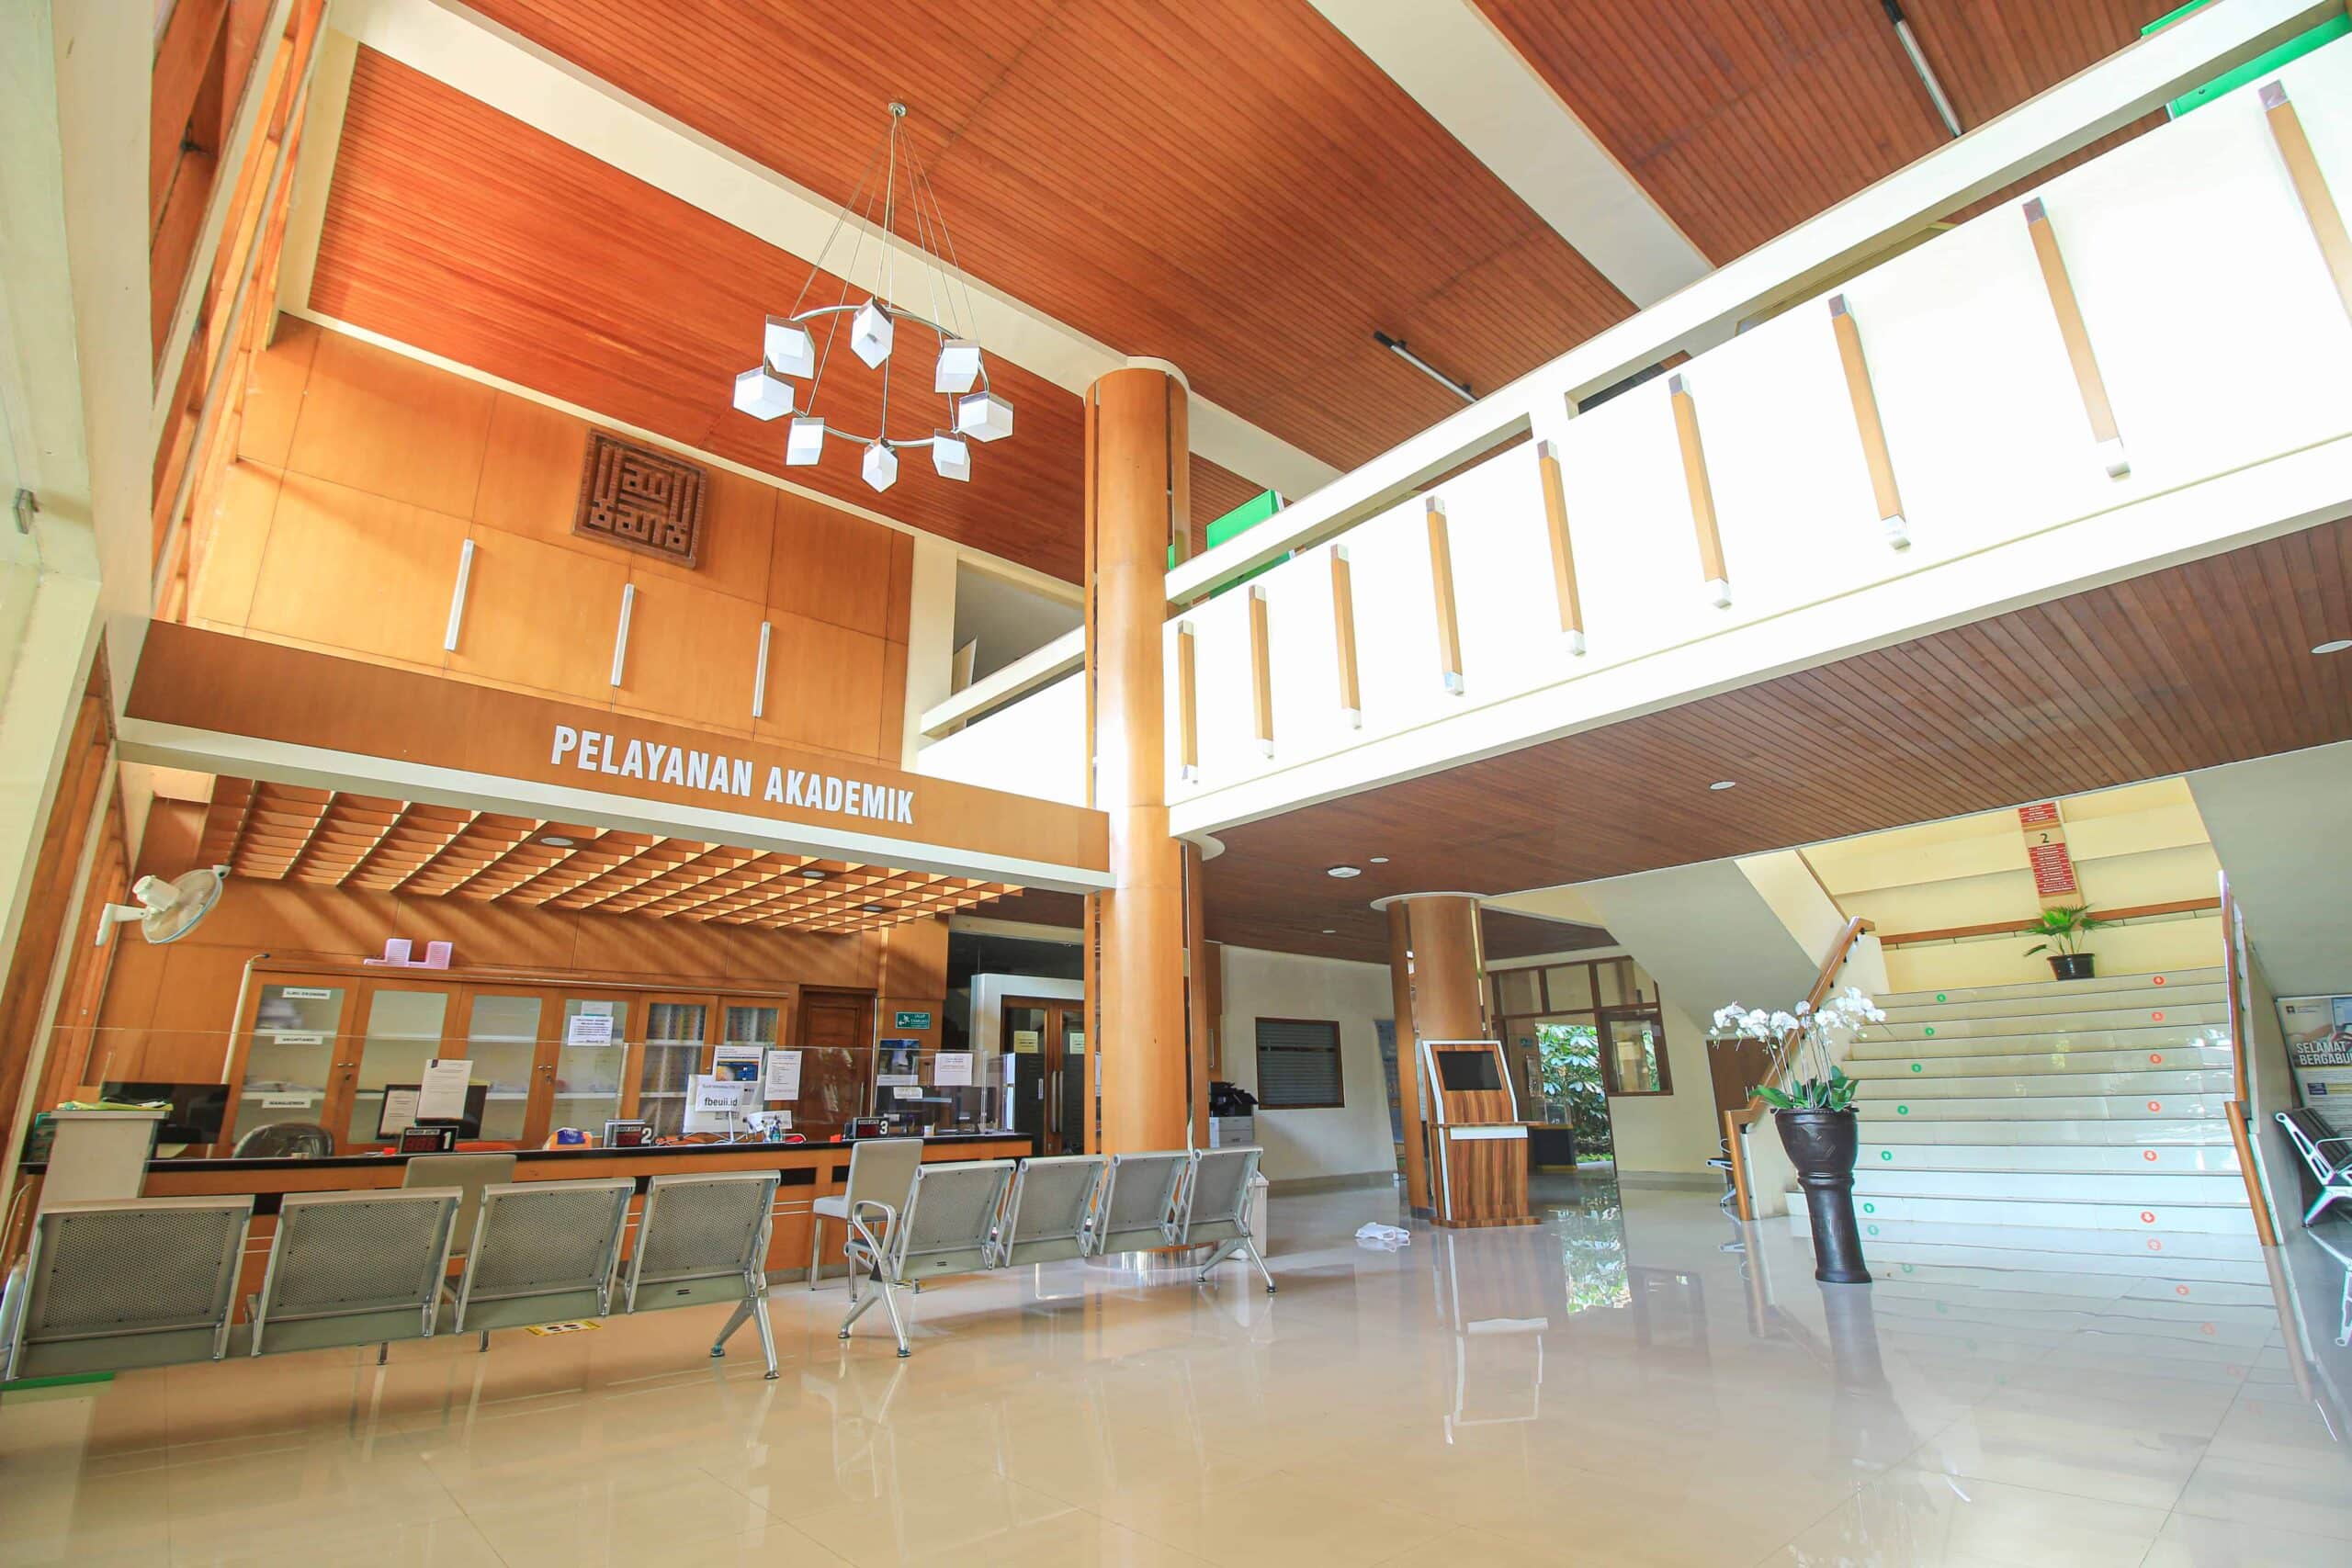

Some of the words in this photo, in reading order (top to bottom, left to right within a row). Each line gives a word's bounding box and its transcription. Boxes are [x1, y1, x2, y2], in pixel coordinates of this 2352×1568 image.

[551, 725, 753, 797] PELAYANAN
[763, 765, 915, 825] AKADEMIK
[2040, 832, 2050, 843] 2
[2296, 1042, 2346, 1054] SELAMAT
[2300, 1053, 2352, 1066] BERGABU
[704, 1097, 738, 1107] fbeuii.id
[879, 1120, 888, 1135] 3
[443, 1131, 452, 1150] 1
[640, 1127, 652, 1145] 2
